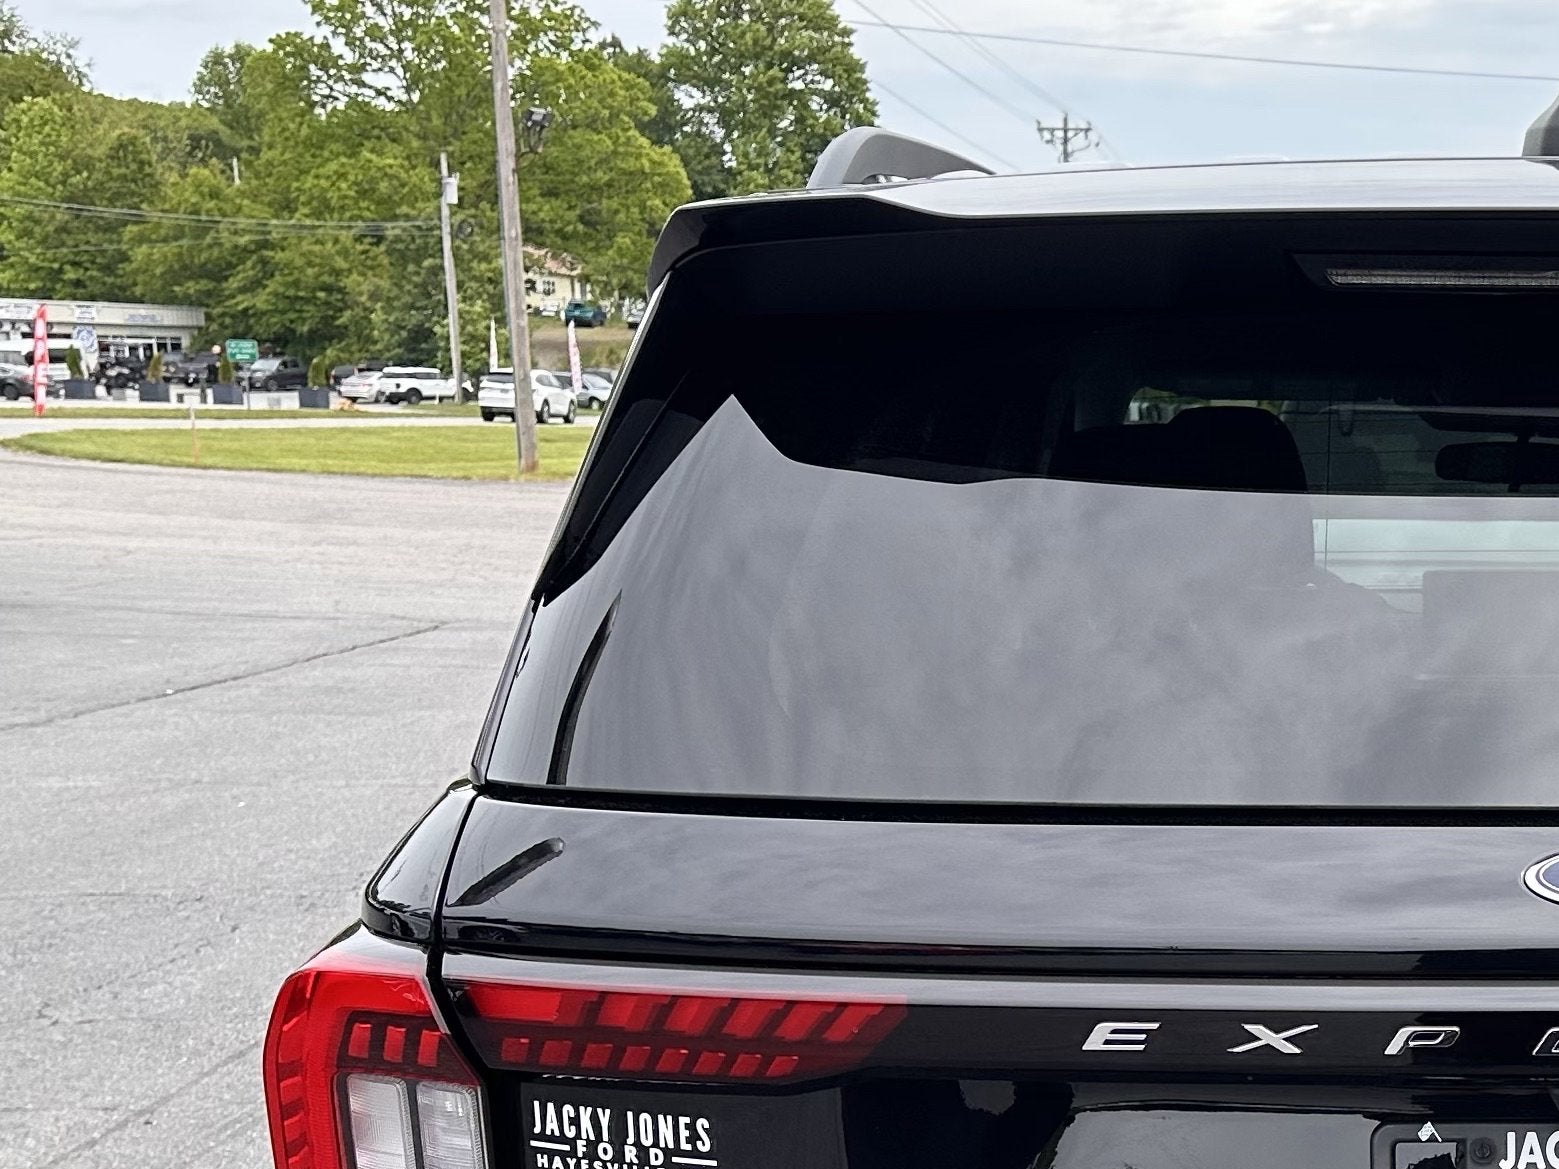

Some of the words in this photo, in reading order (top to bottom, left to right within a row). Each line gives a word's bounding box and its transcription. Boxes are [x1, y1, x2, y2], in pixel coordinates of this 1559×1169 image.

[533, 1100, 611, 1141] JACKY
[626, 1111, 712, 1153] JONES
[576, 1140, 664, 1166] FORD
